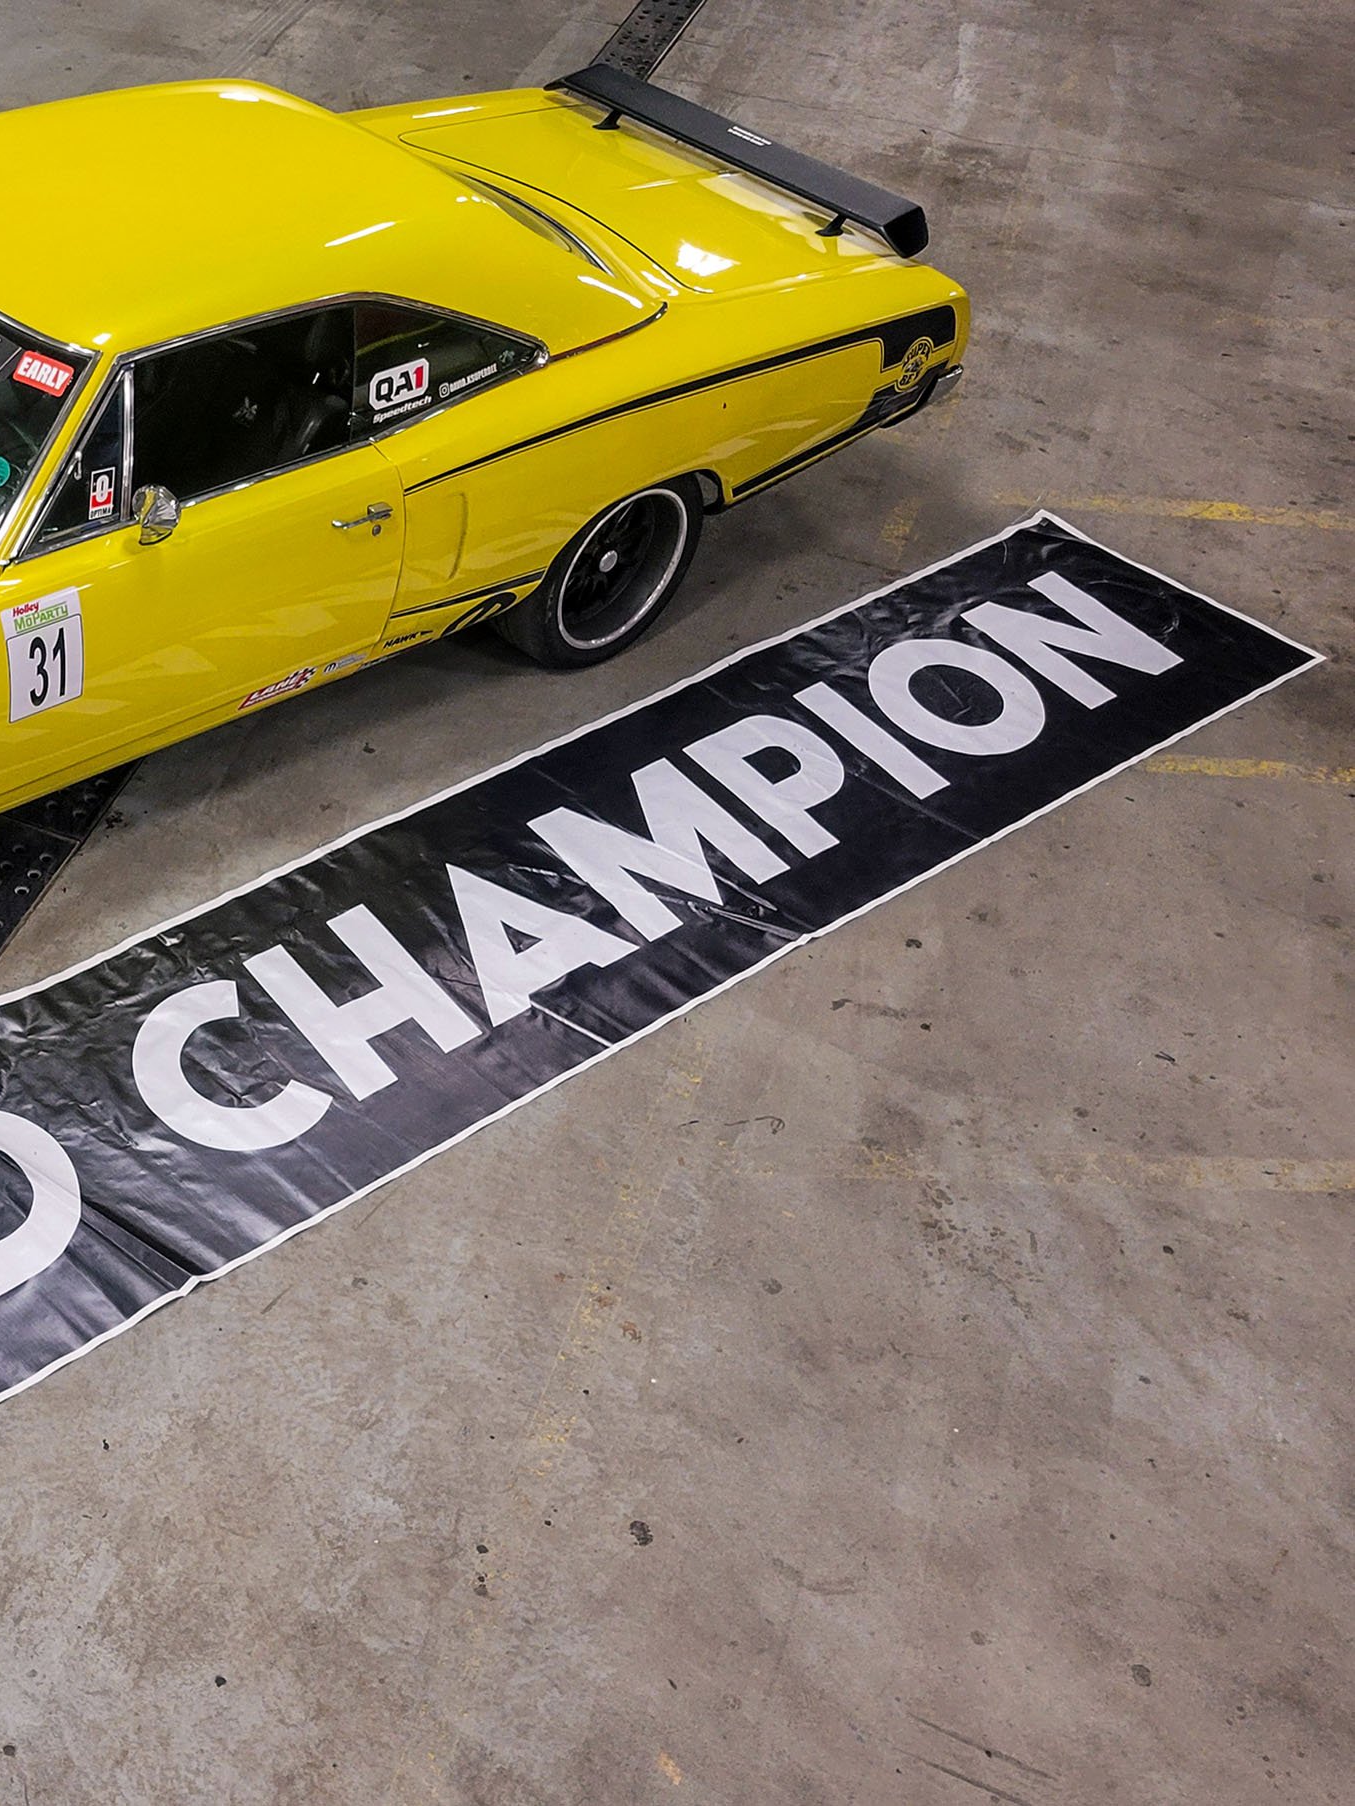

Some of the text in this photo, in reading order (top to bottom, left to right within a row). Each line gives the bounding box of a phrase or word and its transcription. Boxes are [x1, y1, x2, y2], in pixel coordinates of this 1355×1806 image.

[17, 356, 70, 391] EARLY
[375, 365, 424, 404] QA1
[372, 395, 432, 425] Speedtech
[90, 504, 113, 519] OPTIMA
[12, 601, 40, 618] Holley
[382, 631, 419, 649] HAWK
[29, 627, 66, 707] 31
[132, 572, 1184, 1151] CHAMPION
